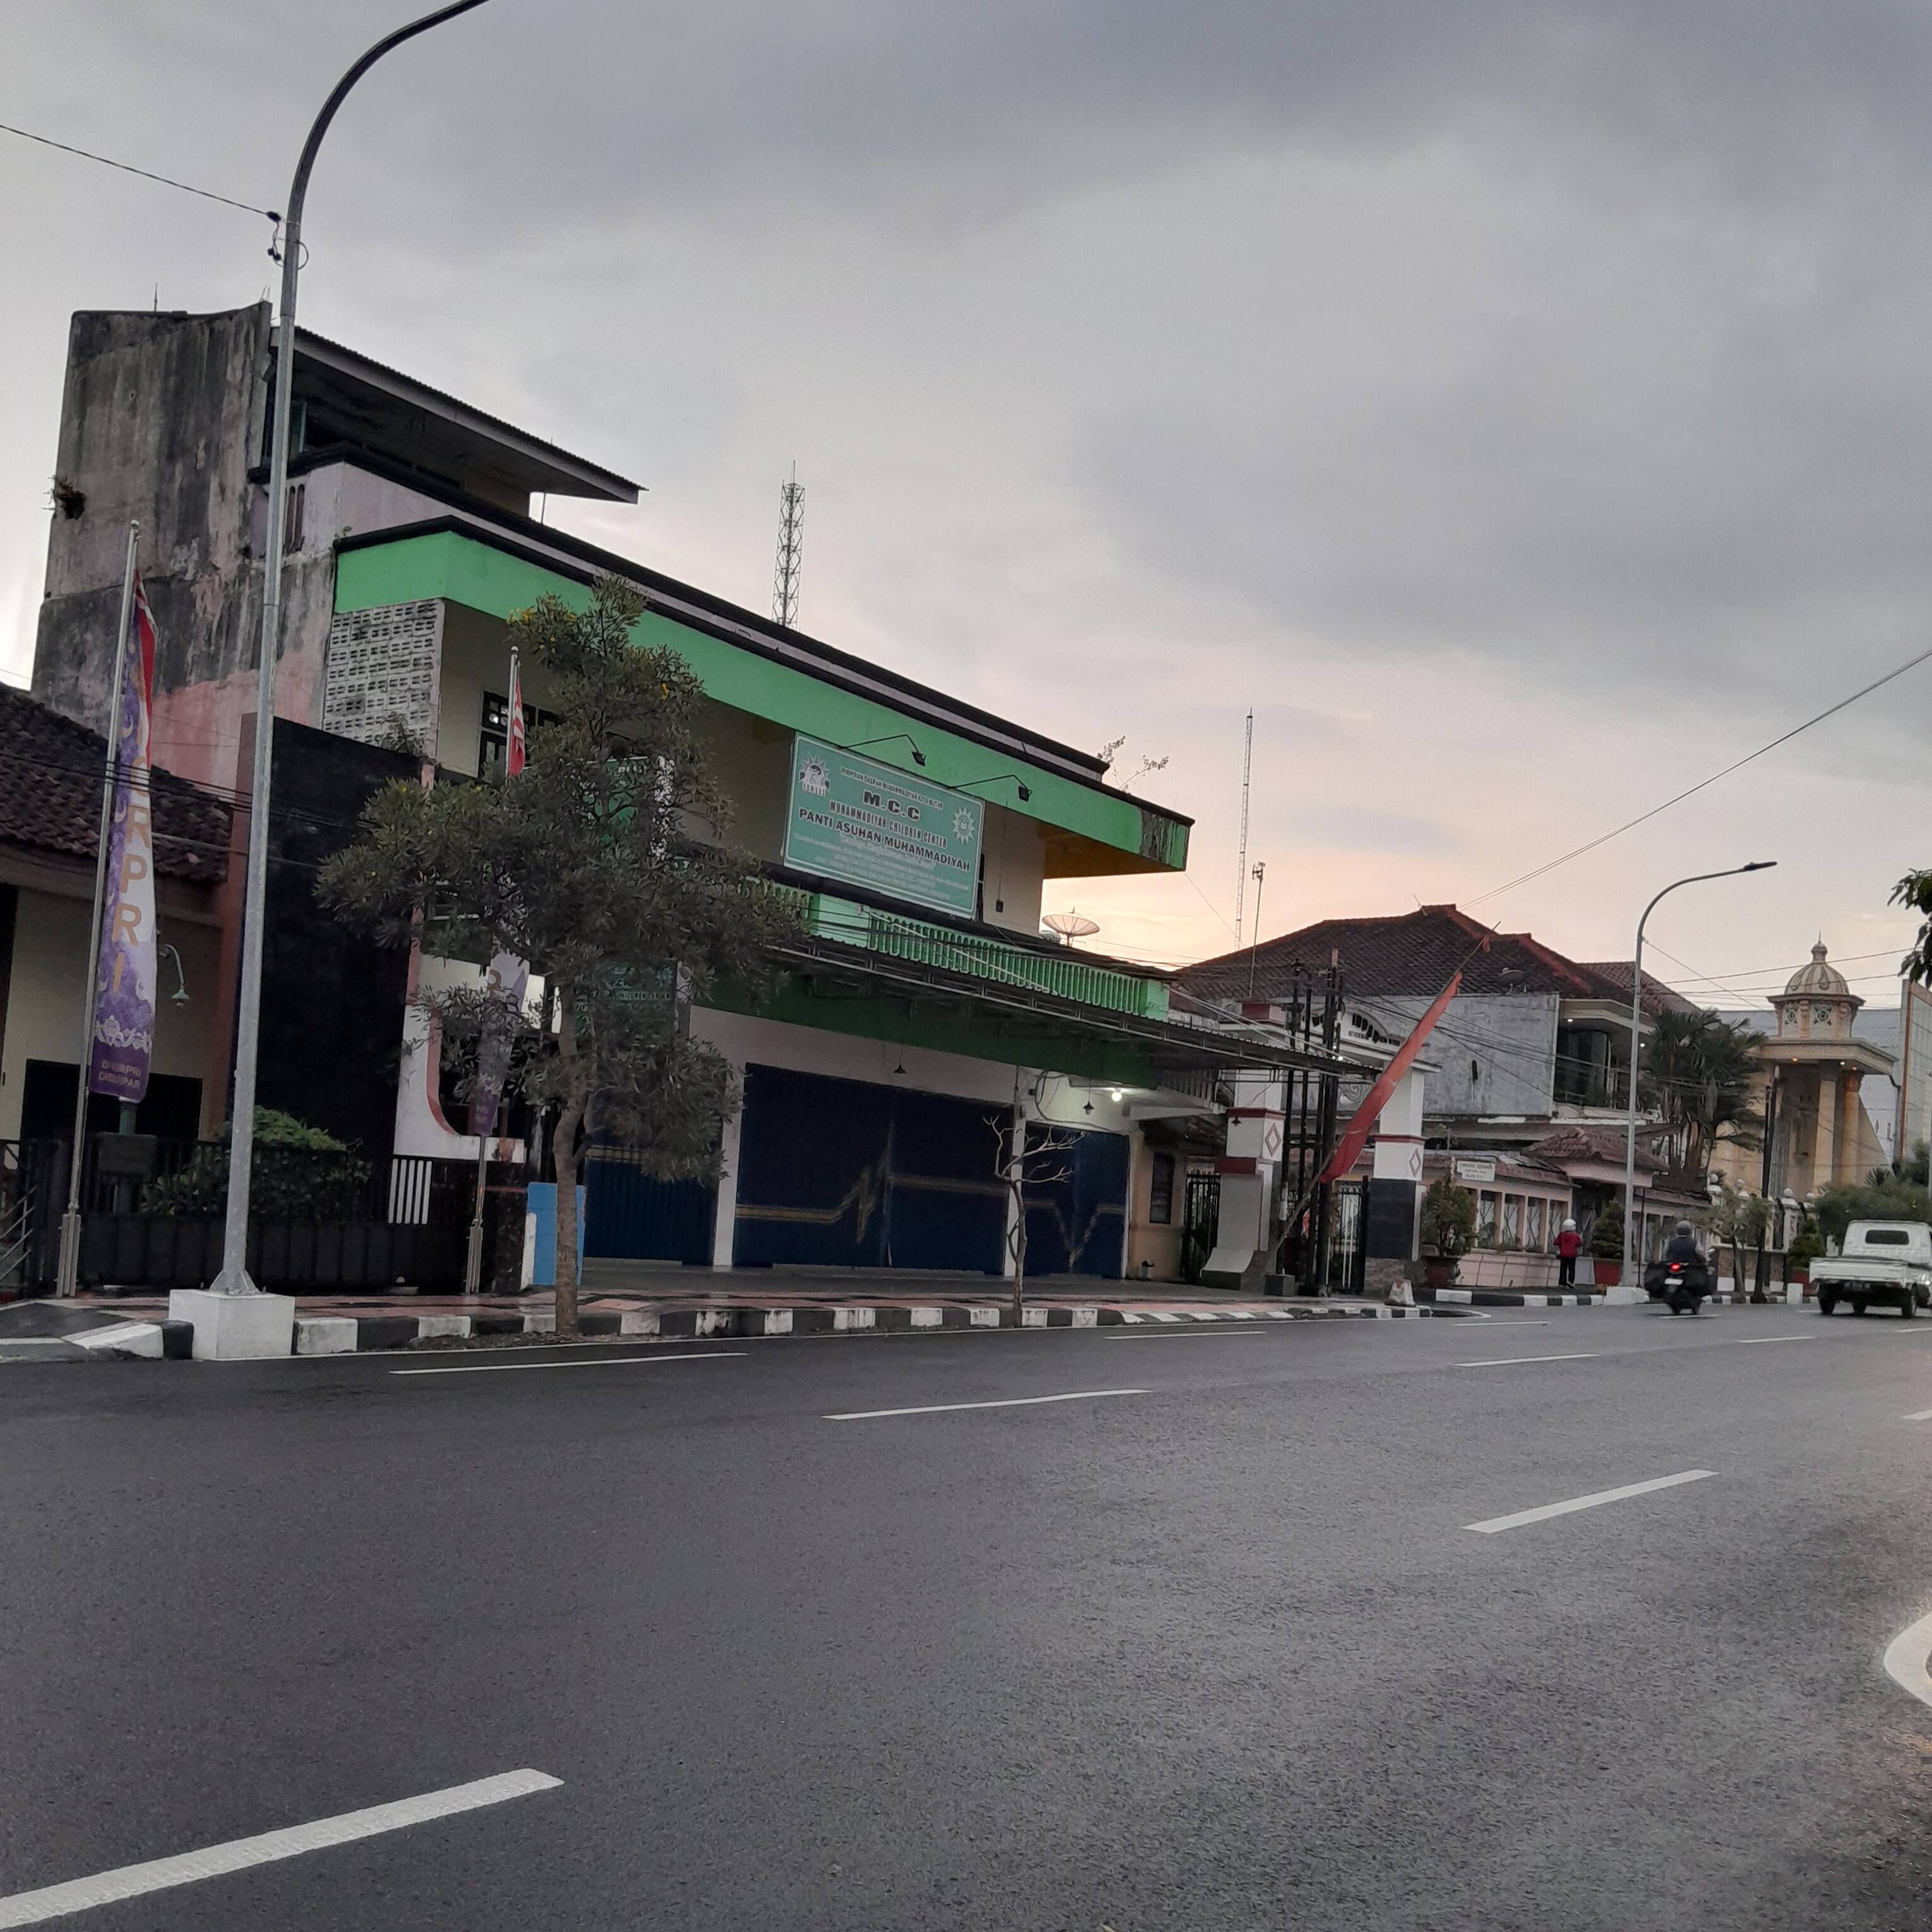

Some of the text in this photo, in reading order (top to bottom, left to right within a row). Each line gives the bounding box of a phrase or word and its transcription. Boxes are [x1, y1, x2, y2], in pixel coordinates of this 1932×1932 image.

[799, 808, 833, 828] PANTI
[835, 820, 882, 844] ASUHAN
[884, 835, 970, 872] MUHAMMADIYAH
[830, 800, 947, 849] MUHAMMADIYAH CHILDREN CENTER
